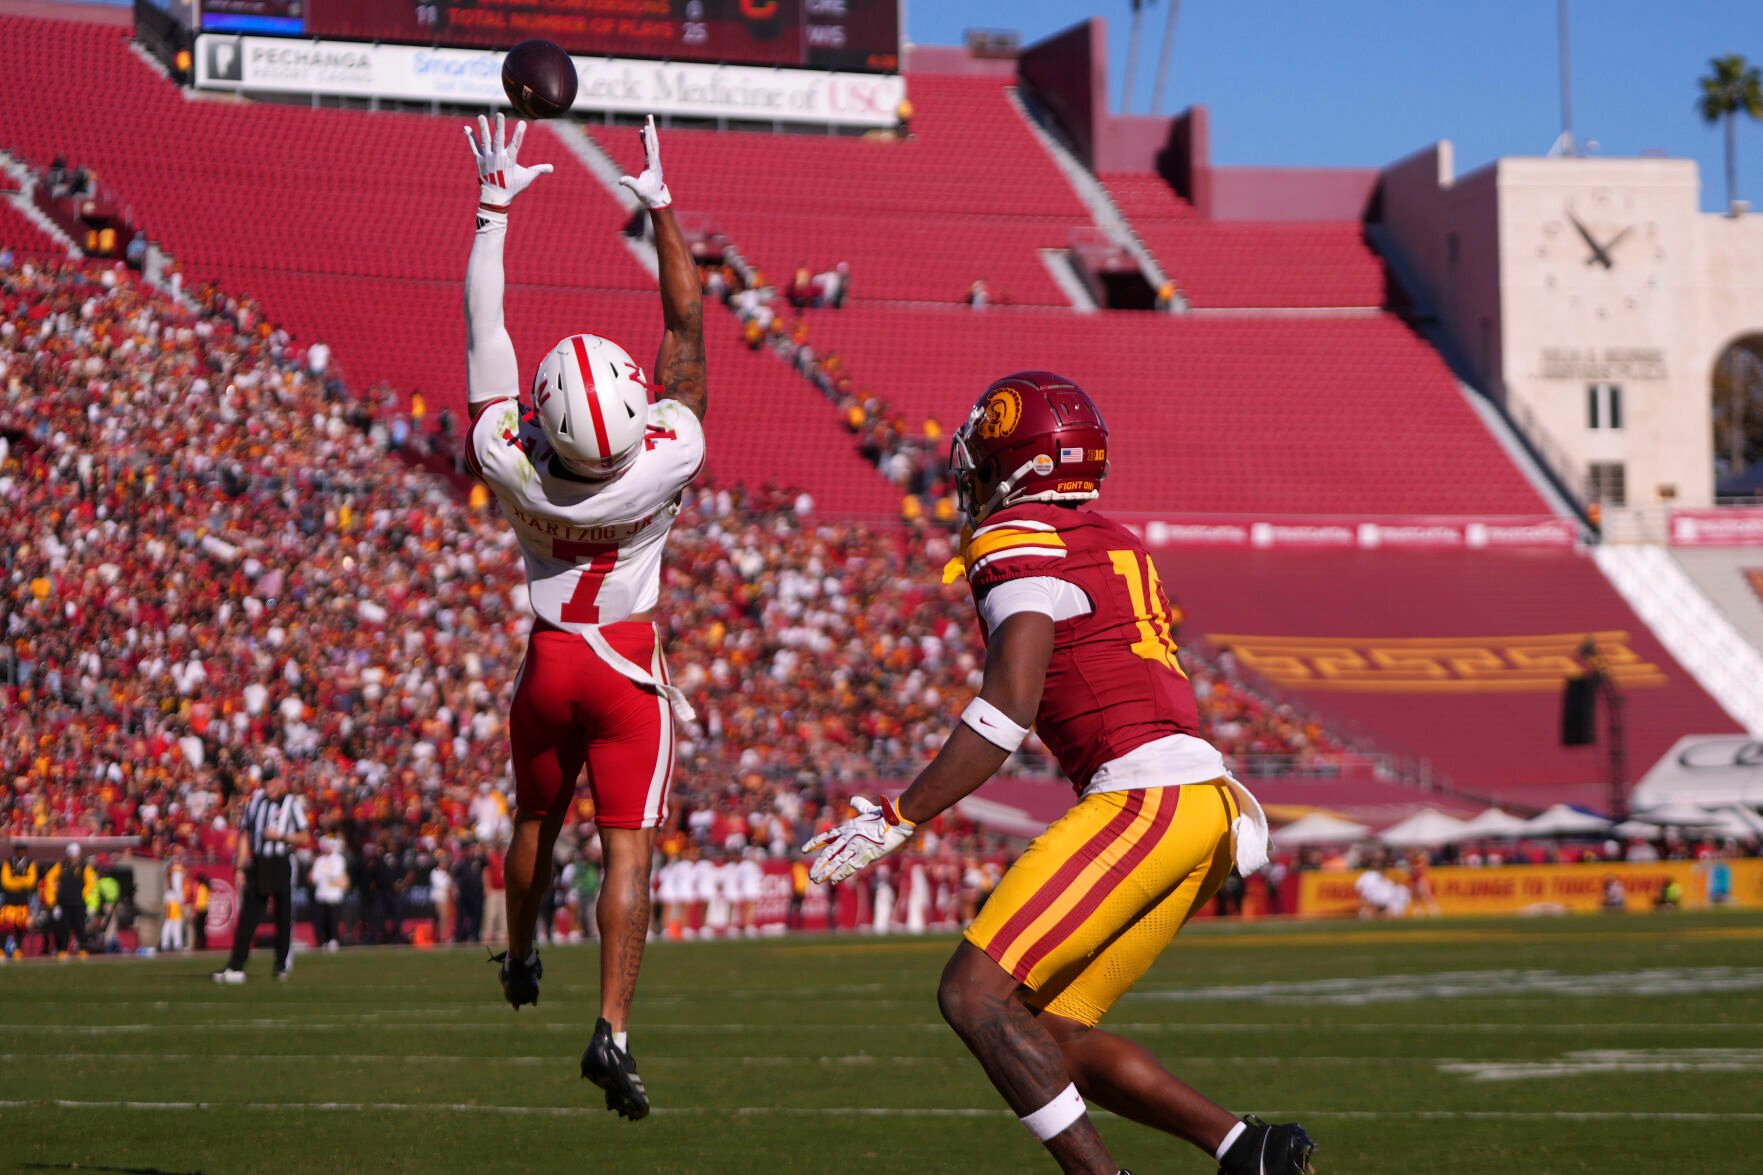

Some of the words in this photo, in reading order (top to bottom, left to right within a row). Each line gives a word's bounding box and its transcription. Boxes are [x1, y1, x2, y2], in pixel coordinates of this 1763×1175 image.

[253, 48, 370, 68] PECHANGA
[653, 69, 786, 107] Medicine
[790, 78, 822, 110] of
[828, 81, 897, 113] USC
[1057, 480, 1083, 492] FIGHT
[552, 538, 619, 624] 7
